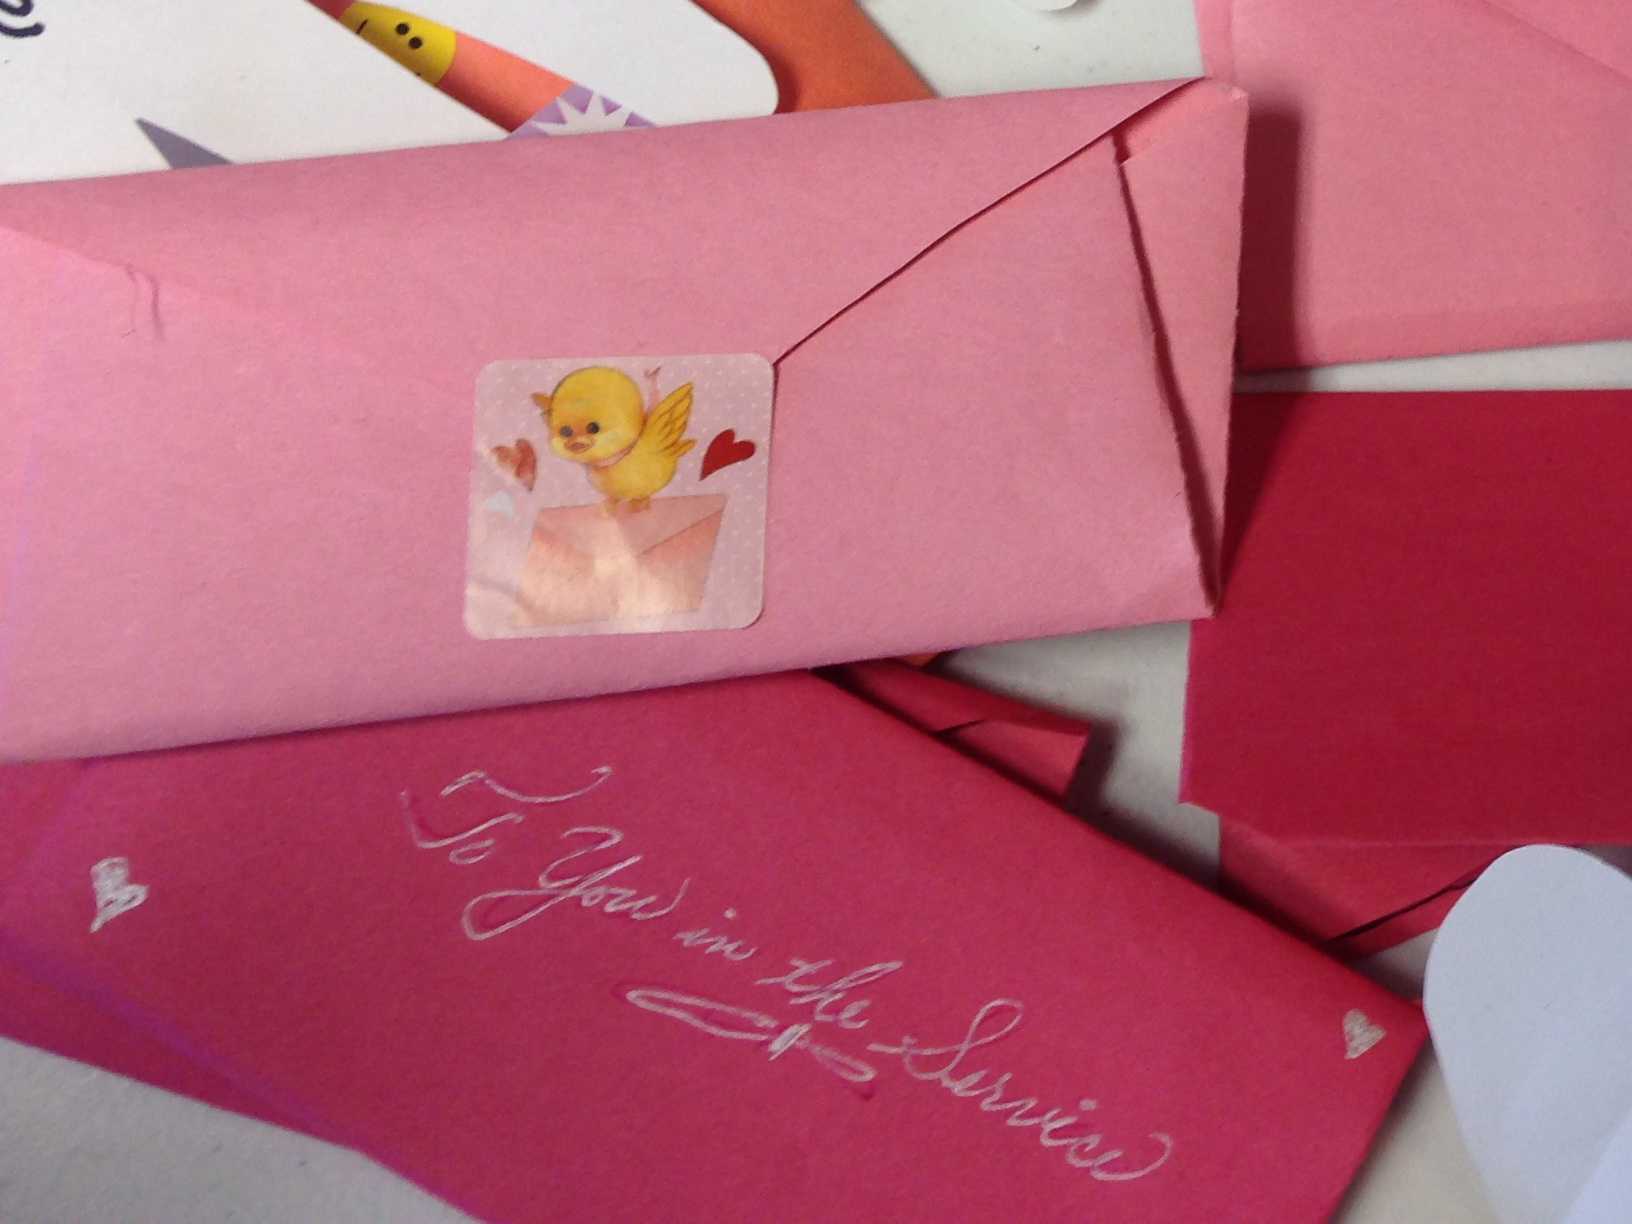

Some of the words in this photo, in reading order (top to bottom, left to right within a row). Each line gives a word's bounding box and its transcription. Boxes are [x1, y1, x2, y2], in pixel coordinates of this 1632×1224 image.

[400, 765, 613, 865] To
[461, 825, 692, 941] You
[672, 907, 757, 963] in
[754, 959, 904, 1030] the
[867, 998, 1174, 1182] Service
